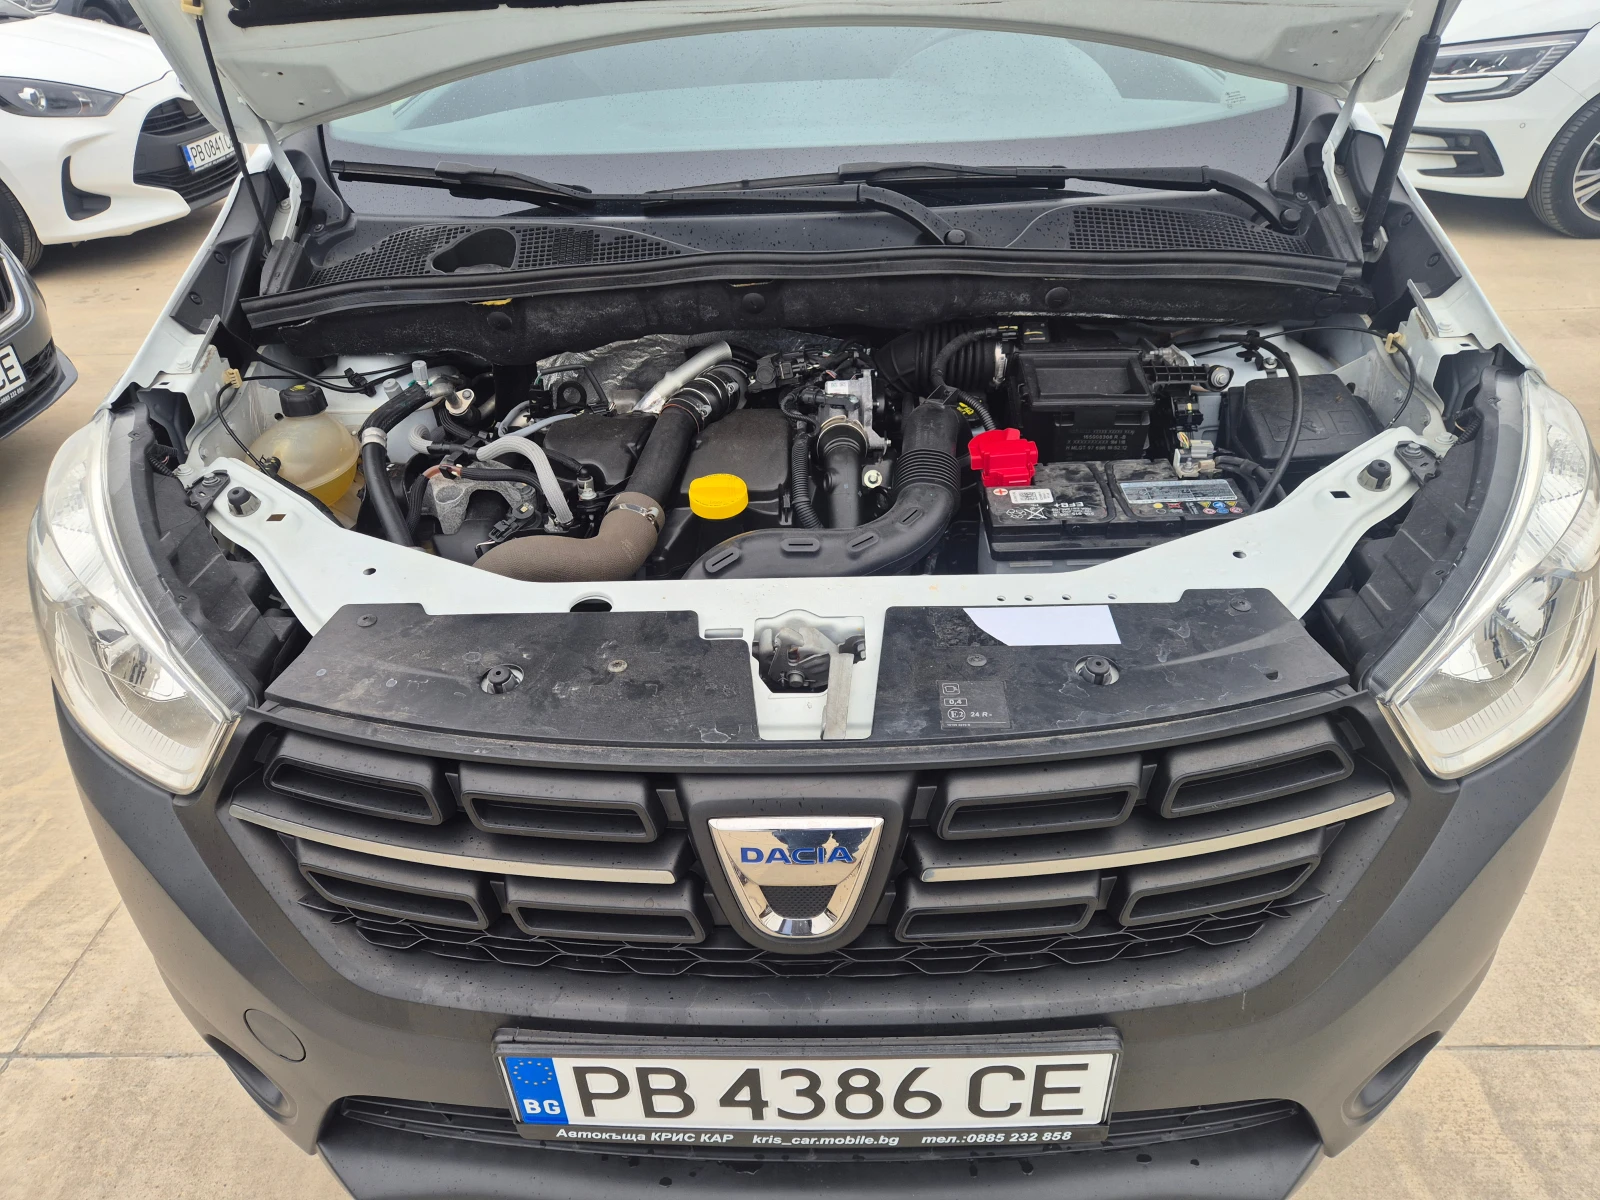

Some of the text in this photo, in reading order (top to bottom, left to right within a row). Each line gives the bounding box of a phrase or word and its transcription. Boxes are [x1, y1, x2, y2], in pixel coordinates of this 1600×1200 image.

[190, 144, 206, 164] PB
[203, 135, 226, 158] 0841
[741, 846, 854, 865] DACIA
[572, 1062, 1089, 1121] PB 4386 CE
[522, 1099, 561, 1115] BG
[556, 1128, 734, 1143] Автокъща КРИС КАР
[752, 1134, 900, 1146] kris_car.mobile.bg
[1009, 1132, 1038, 1143] 232
[1042, 1131, 1072, 1142] 858
